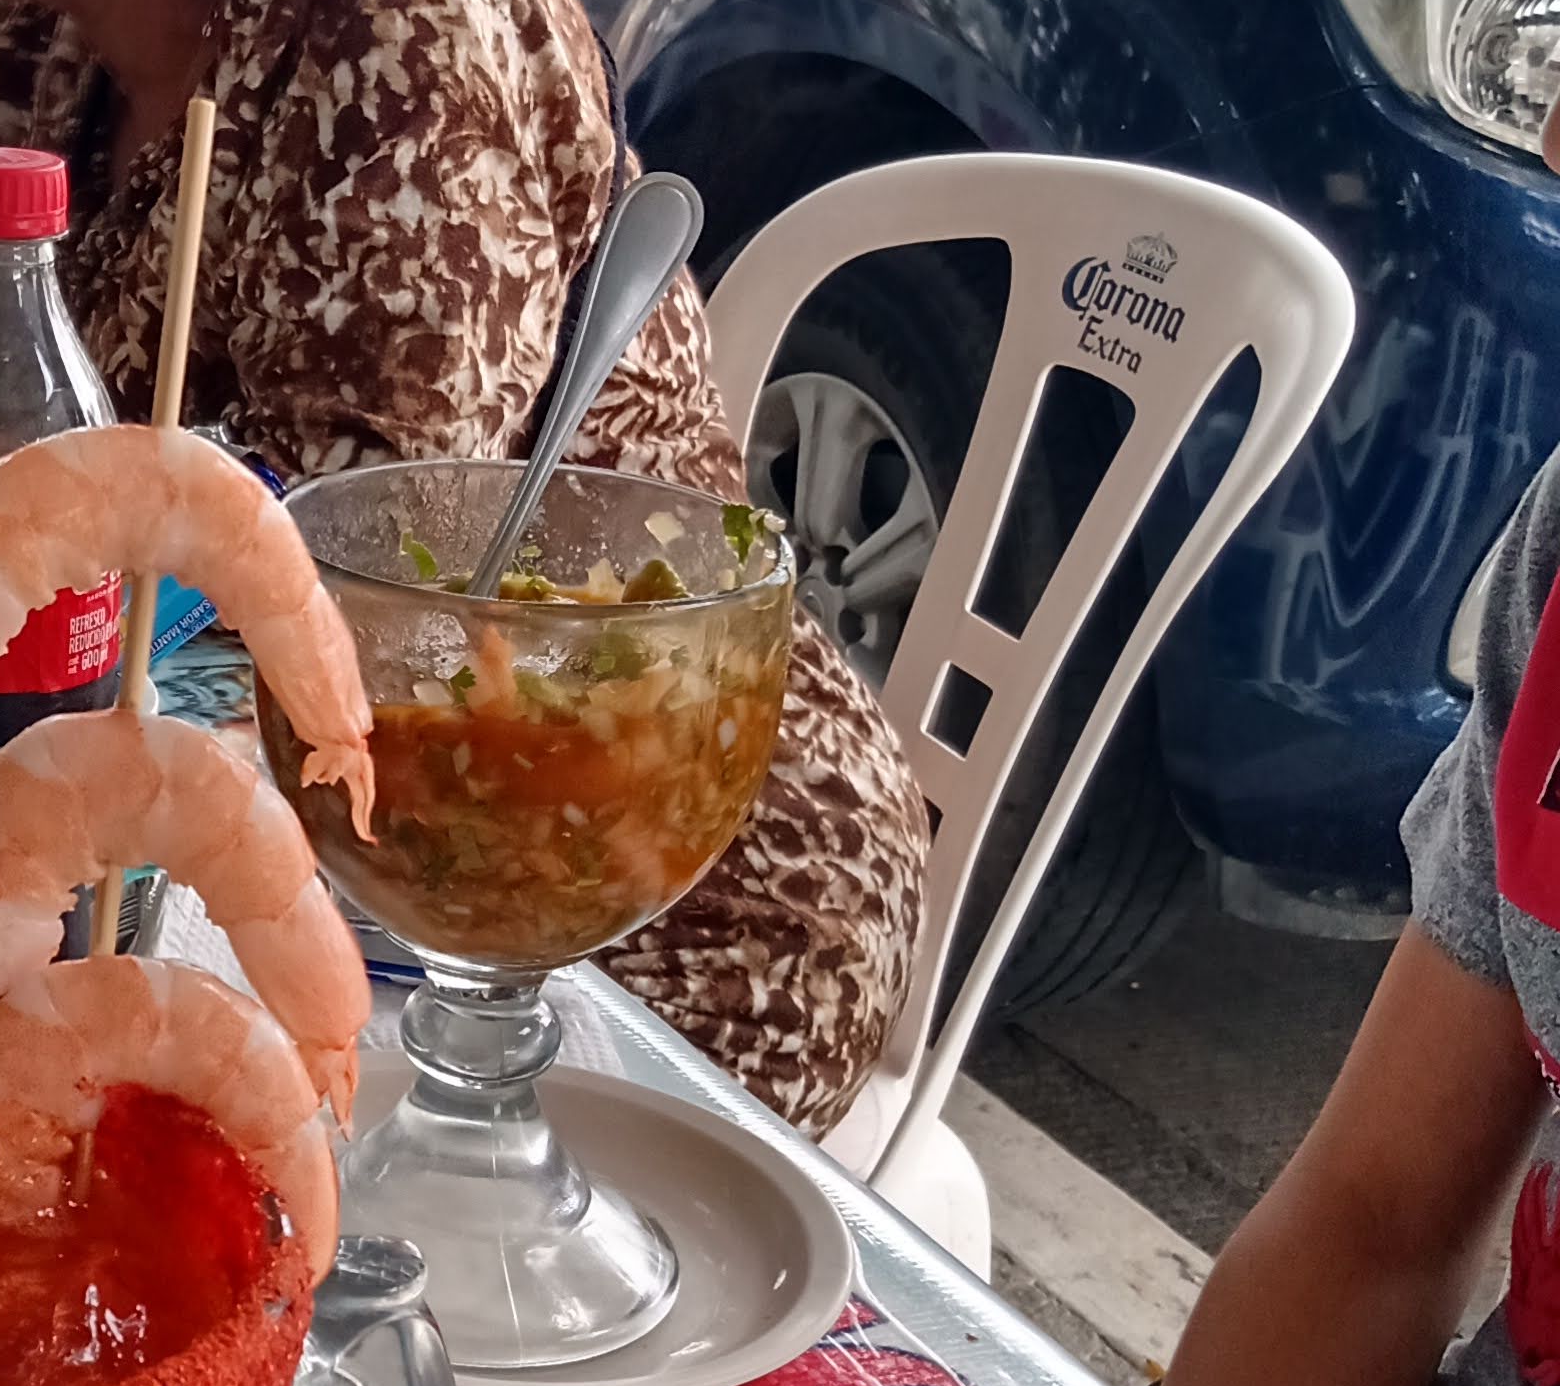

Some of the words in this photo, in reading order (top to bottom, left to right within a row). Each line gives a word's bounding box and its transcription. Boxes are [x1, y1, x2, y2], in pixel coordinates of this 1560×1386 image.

[1061, 256, 1186, 343] Corona
[1077, 315, 1142, 375] Extra
[69, 606, 106, 636] REFRESCO
[179, 598, 212, 629] SABOR
[81, 648, 100, 671] 600
